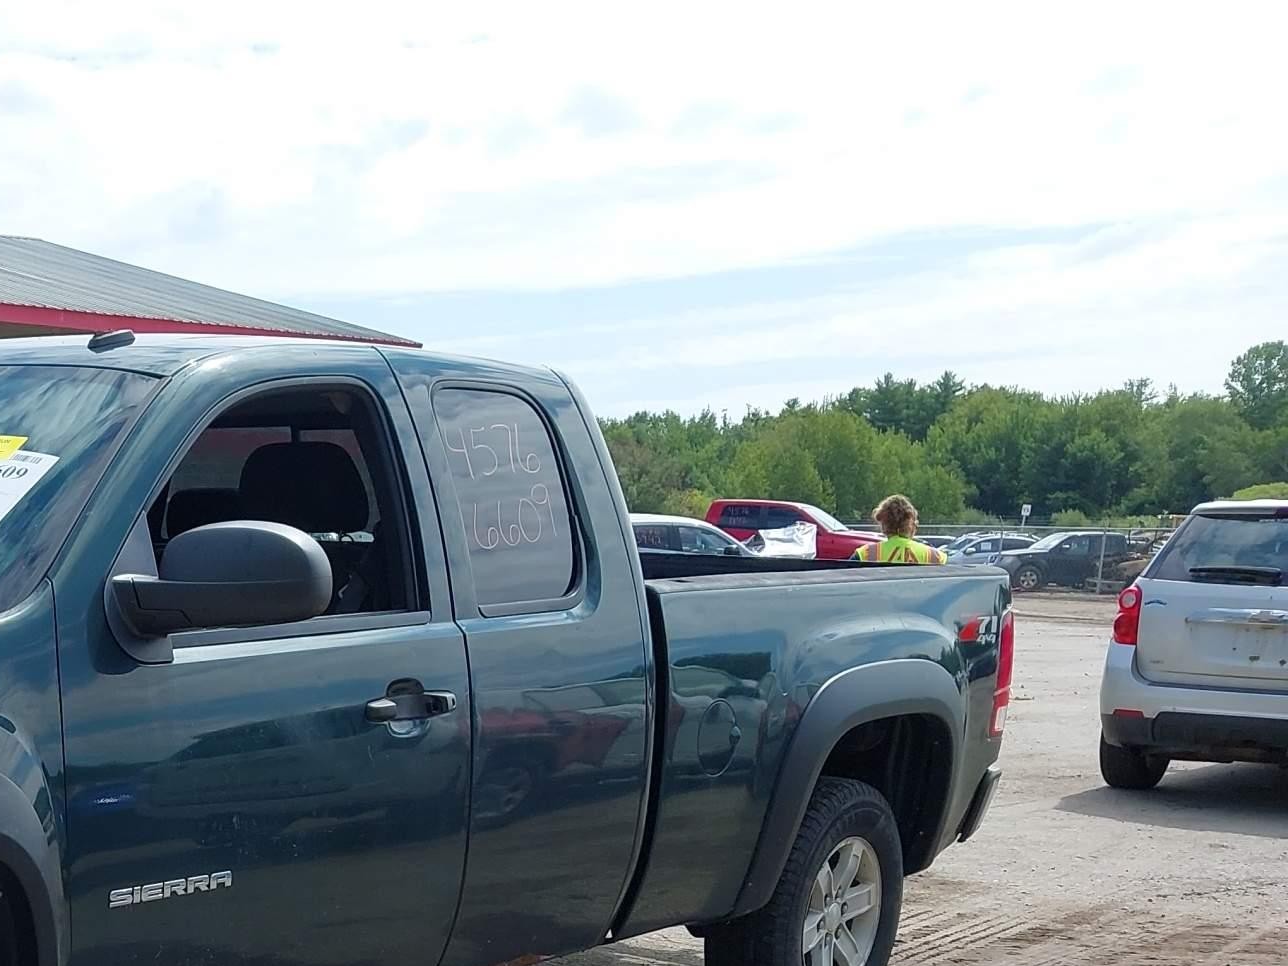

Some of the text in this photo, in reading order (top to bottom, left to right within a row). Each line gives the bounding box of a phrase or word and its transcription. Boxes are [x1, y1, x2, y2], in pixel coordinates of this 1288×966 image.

[444, 423, 541, 480] 4576
[474, 484, 558, 549] 6609
[109, 870, 232, 908] SIERRA
